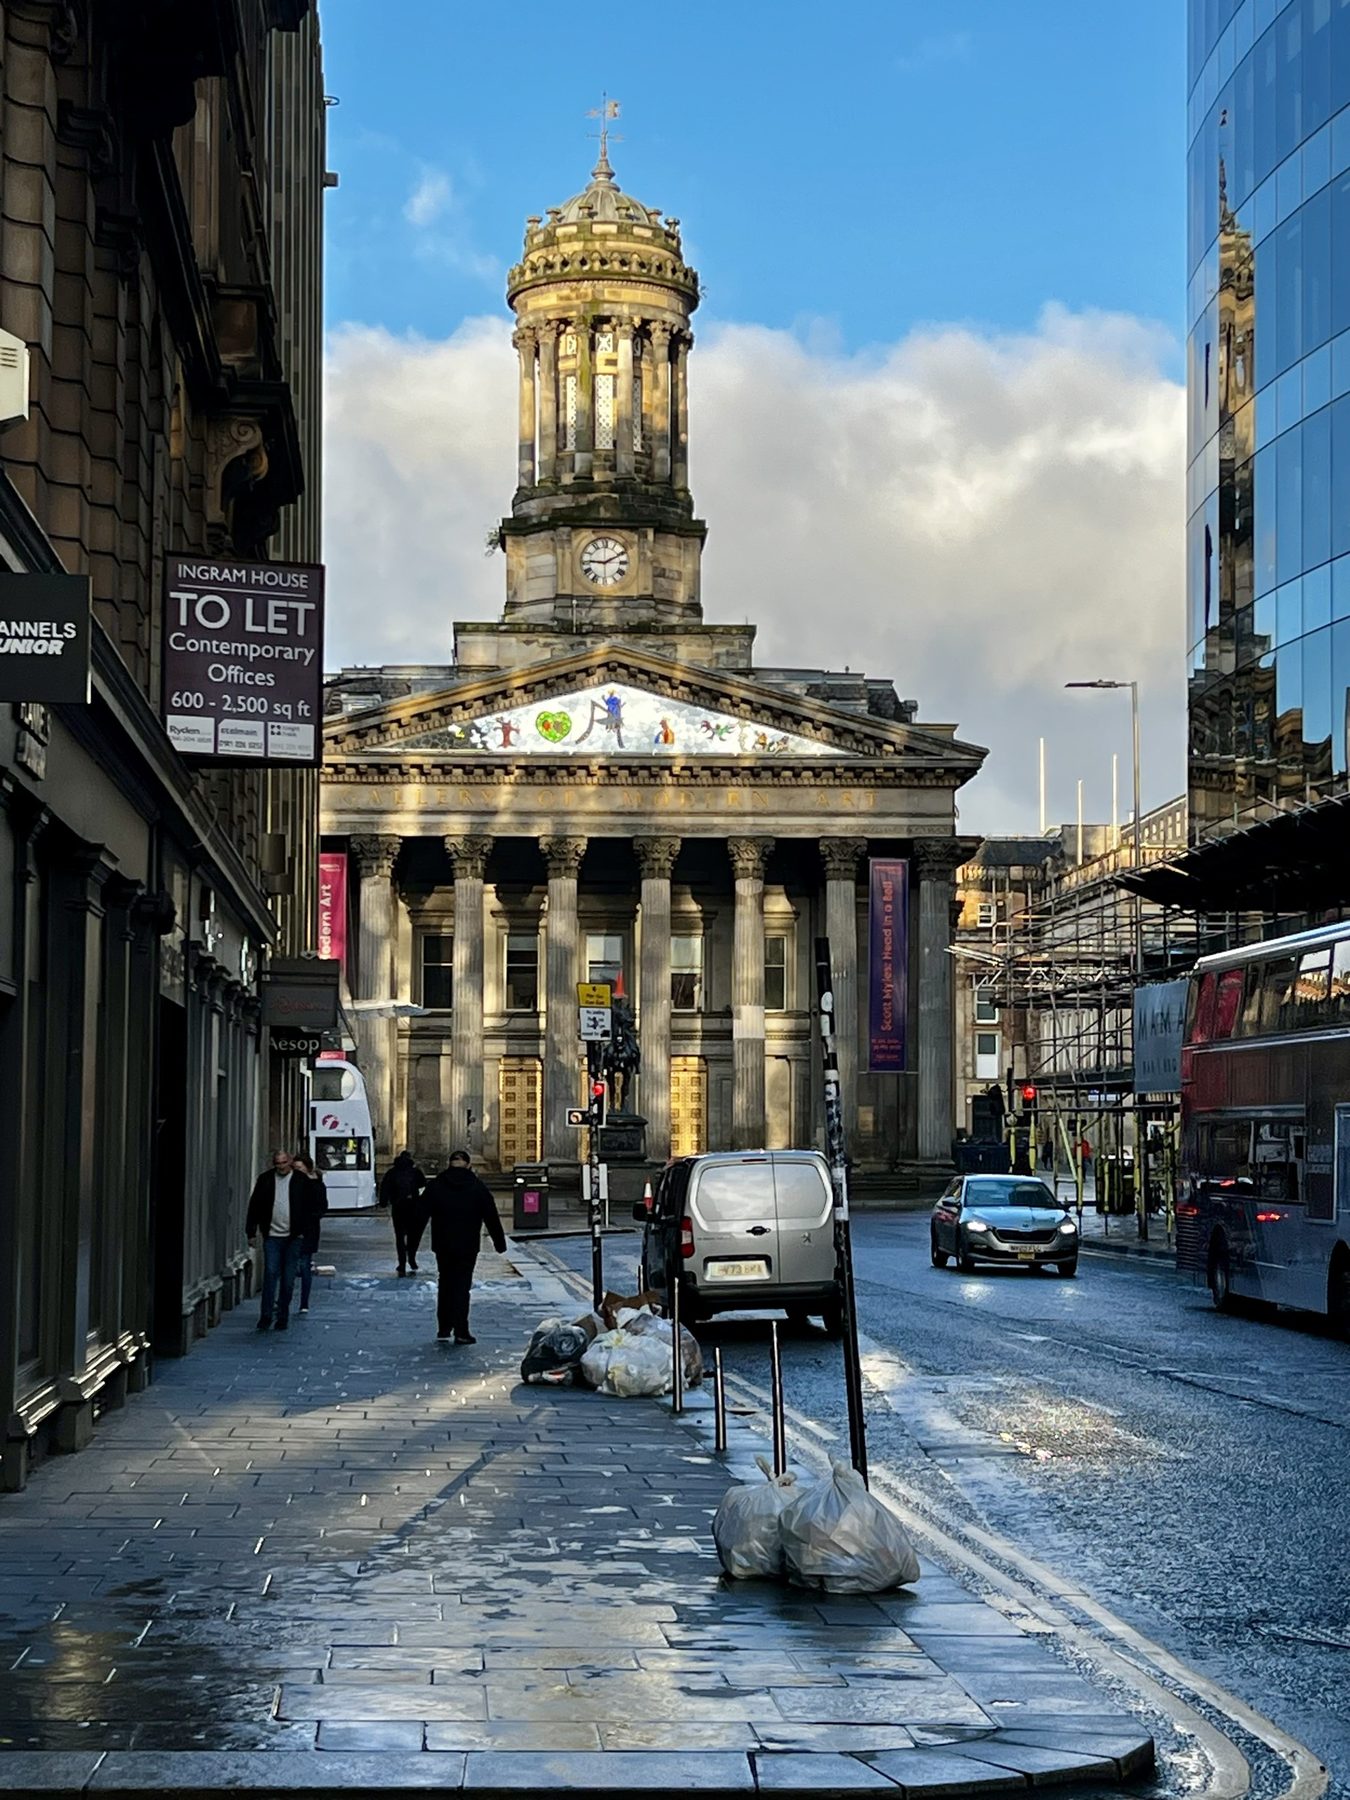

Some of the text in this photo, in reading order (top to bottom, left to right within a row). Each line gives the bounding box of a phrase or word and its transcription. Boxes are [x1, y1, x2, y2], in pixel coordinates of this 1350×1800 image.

[177, 563, 309, 589] INGRAM HOUSE
[169, 591, 316, 636] TO LET
[0, 620, 77, 639] ANNELS
[168, 632, 315, 667] Contemporary
[207, 663, 276, 687] Offices
[171, 691, 204, 709] 600
[221, 694, 269, 714] 2,500
[272, 702, 292, 720] sq
[297, 700, 312, 717] ft
[319, 883, 332, 908] Art
